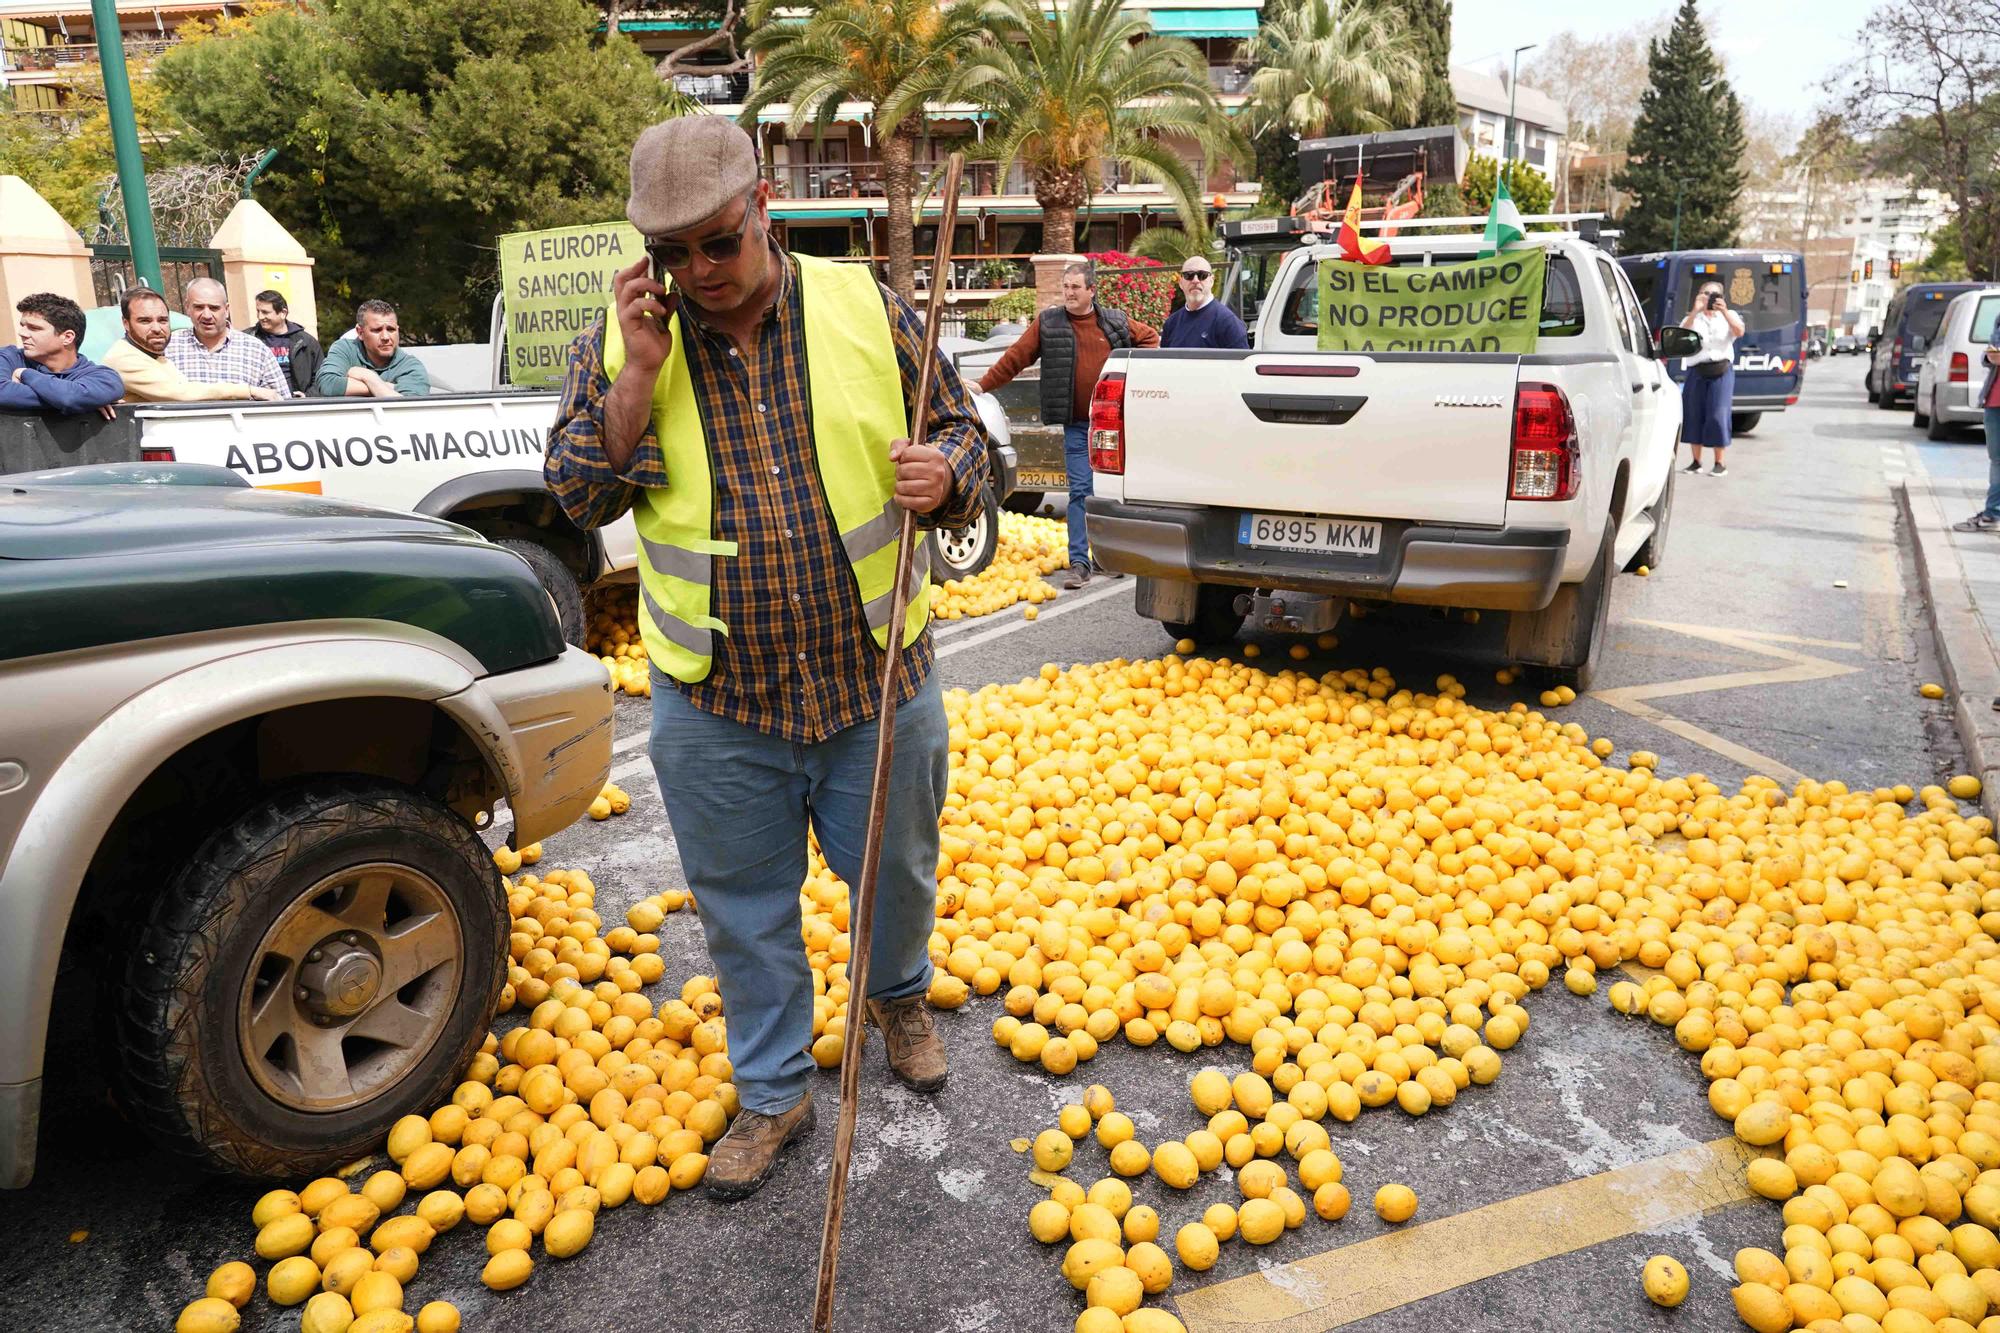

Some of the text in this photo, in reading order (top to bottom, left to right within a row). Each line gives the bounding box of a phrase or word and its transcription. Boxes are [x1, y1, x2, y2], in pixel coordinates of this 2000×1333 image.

[523, 232, 623, 264] A EUROPA
[518, 270, 603, 299] SANCION
[1329, 261, 1523, 293] SI EL CAMPO
[1329, 296, 1528, 328] NO PRODUCE
[1130, 389, 1170, 399] TOYOTA
[1434, 394, 1505, 408] HILUX
[225, 426, 553, 475] ABONOS-MAQUIN
[1020, 473, 1047, 486] 2324
[1257, 519, 1317, 544] 6895
[1326, 523, 1375, 549] MKM
